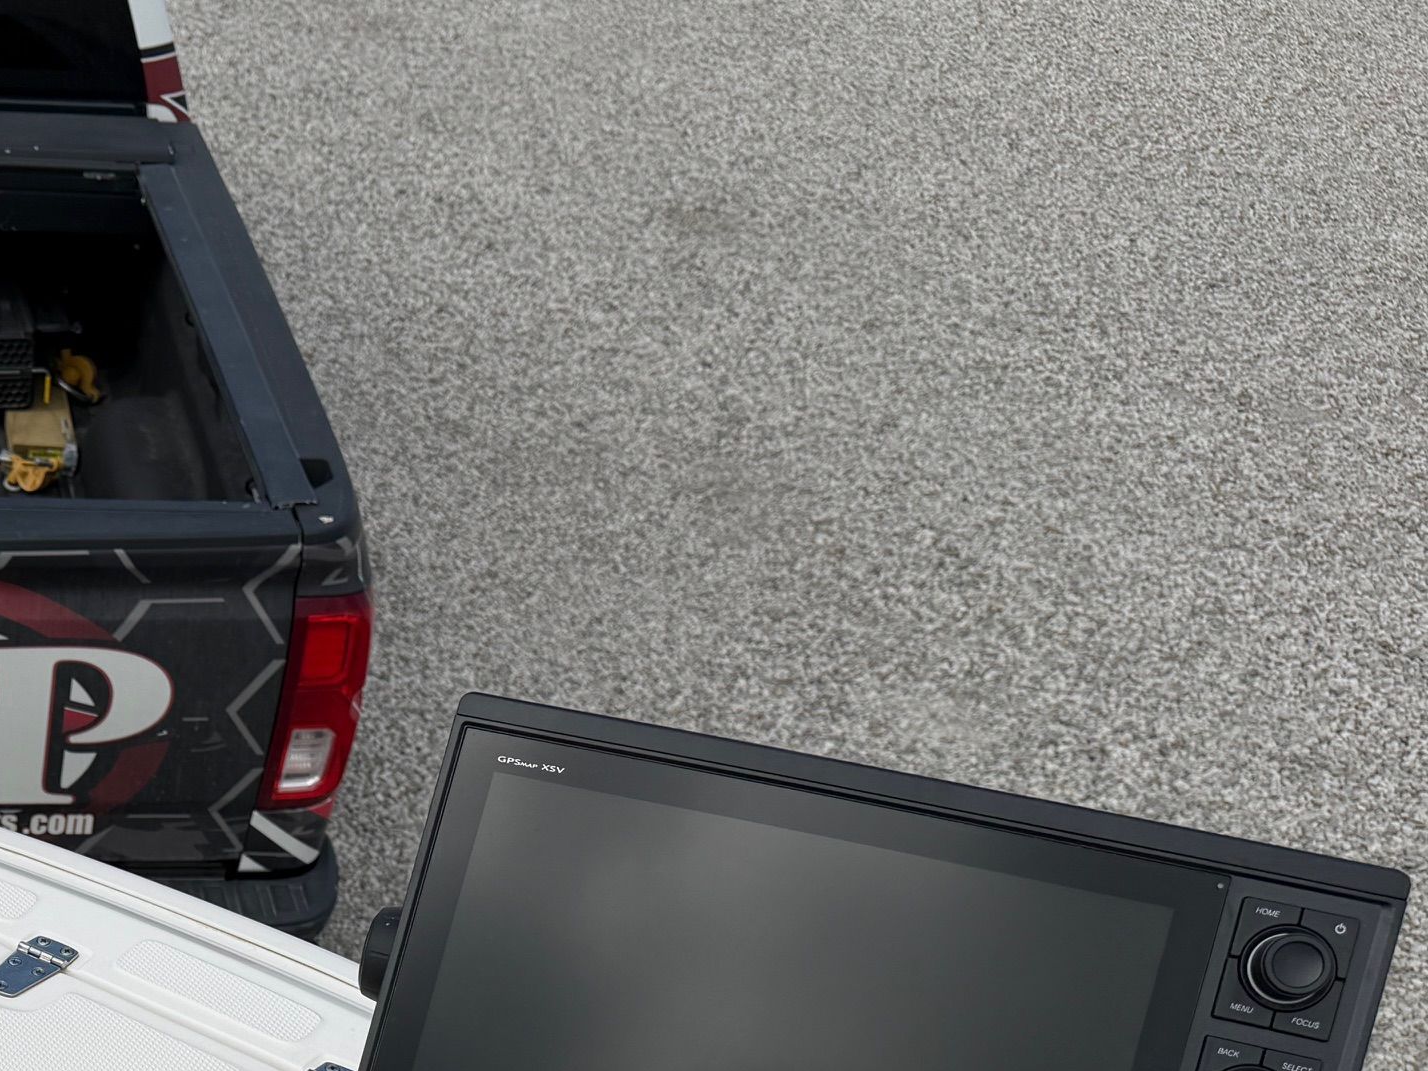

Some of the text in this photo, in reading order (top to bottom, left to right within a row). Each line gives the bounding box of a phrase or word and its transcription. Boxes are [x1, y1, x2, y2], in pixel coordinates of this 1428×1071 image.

[541, 763, 565, 774] XSV
[1255, 906, 1281, 918] HOME
[1229, 1002, 1255, 1014] MENU
[1291, 1017, 1320, 1030] FOCUS
[1217, 1047, 1240, 1058] BACK
